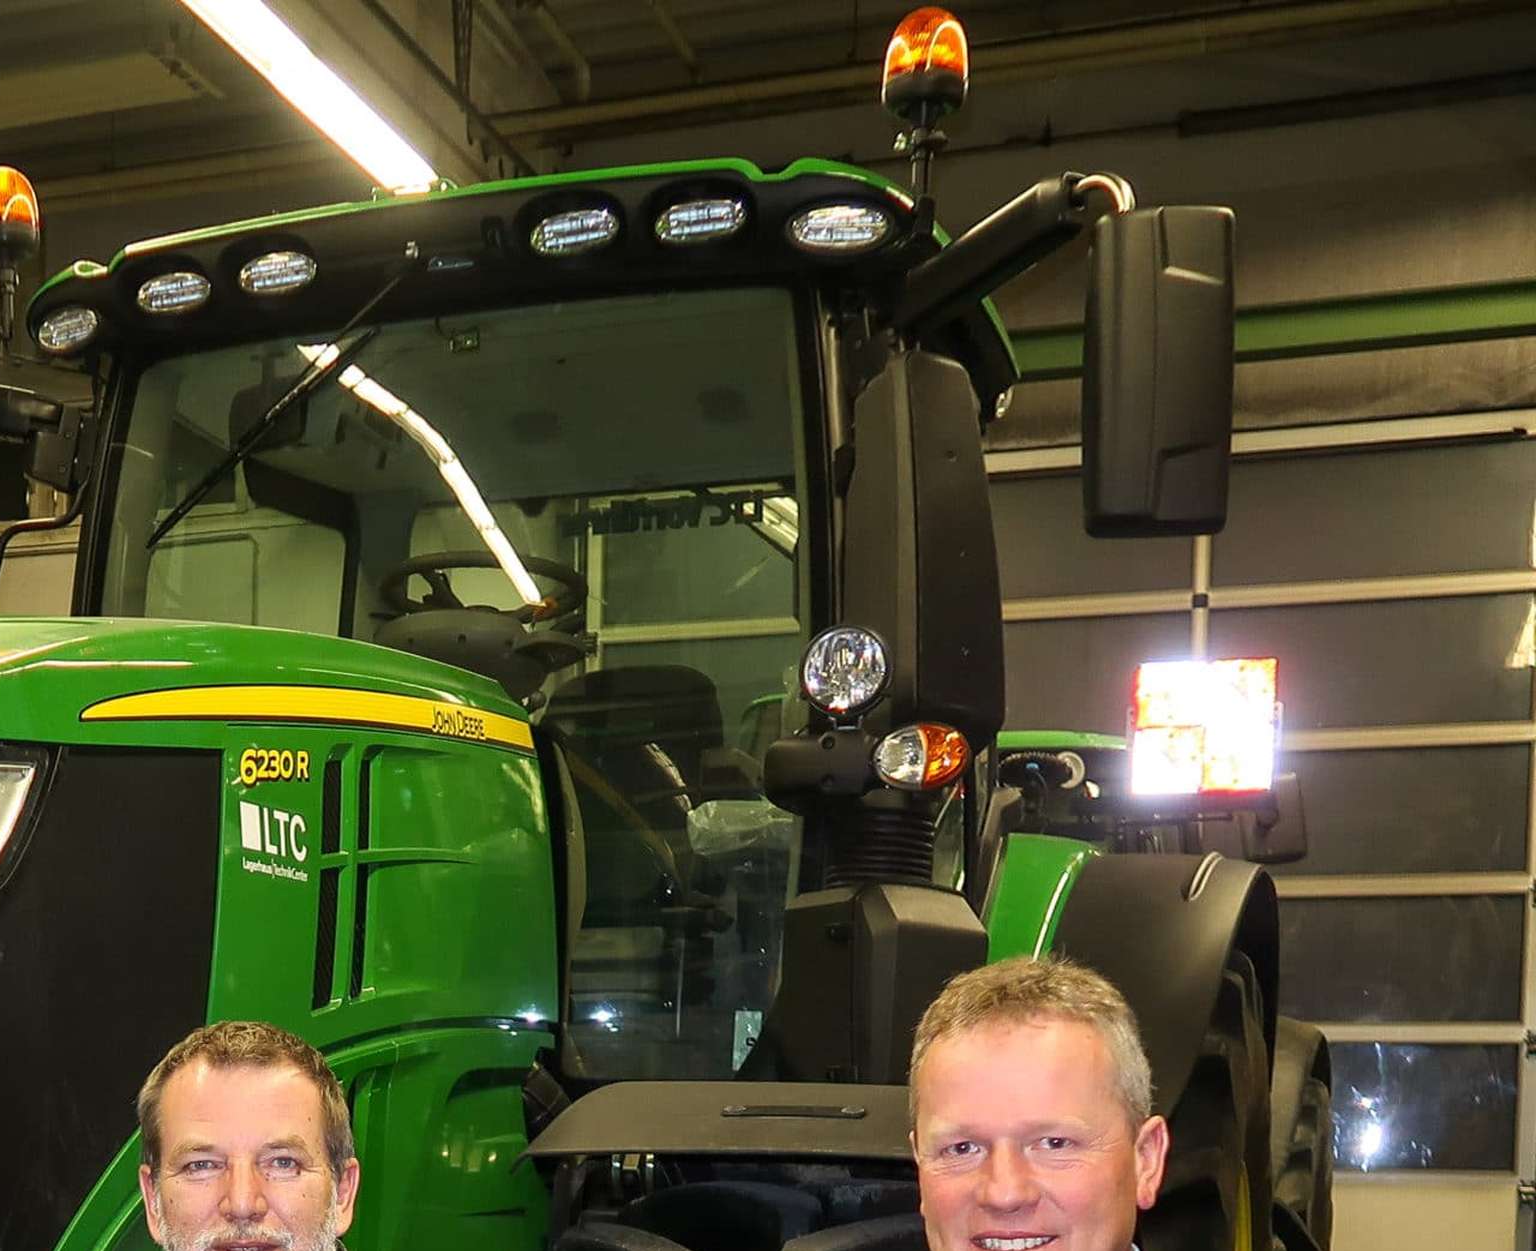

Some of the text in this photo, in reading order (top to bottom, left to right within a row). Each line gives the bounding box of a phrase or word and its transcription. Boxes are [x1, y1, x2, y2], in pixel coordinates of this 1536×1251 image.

[432, 706, 486, 740] JOHN DEERE
[240, 748, 310, 786] 6230 R
[263, 806, 308, 862] LTC
